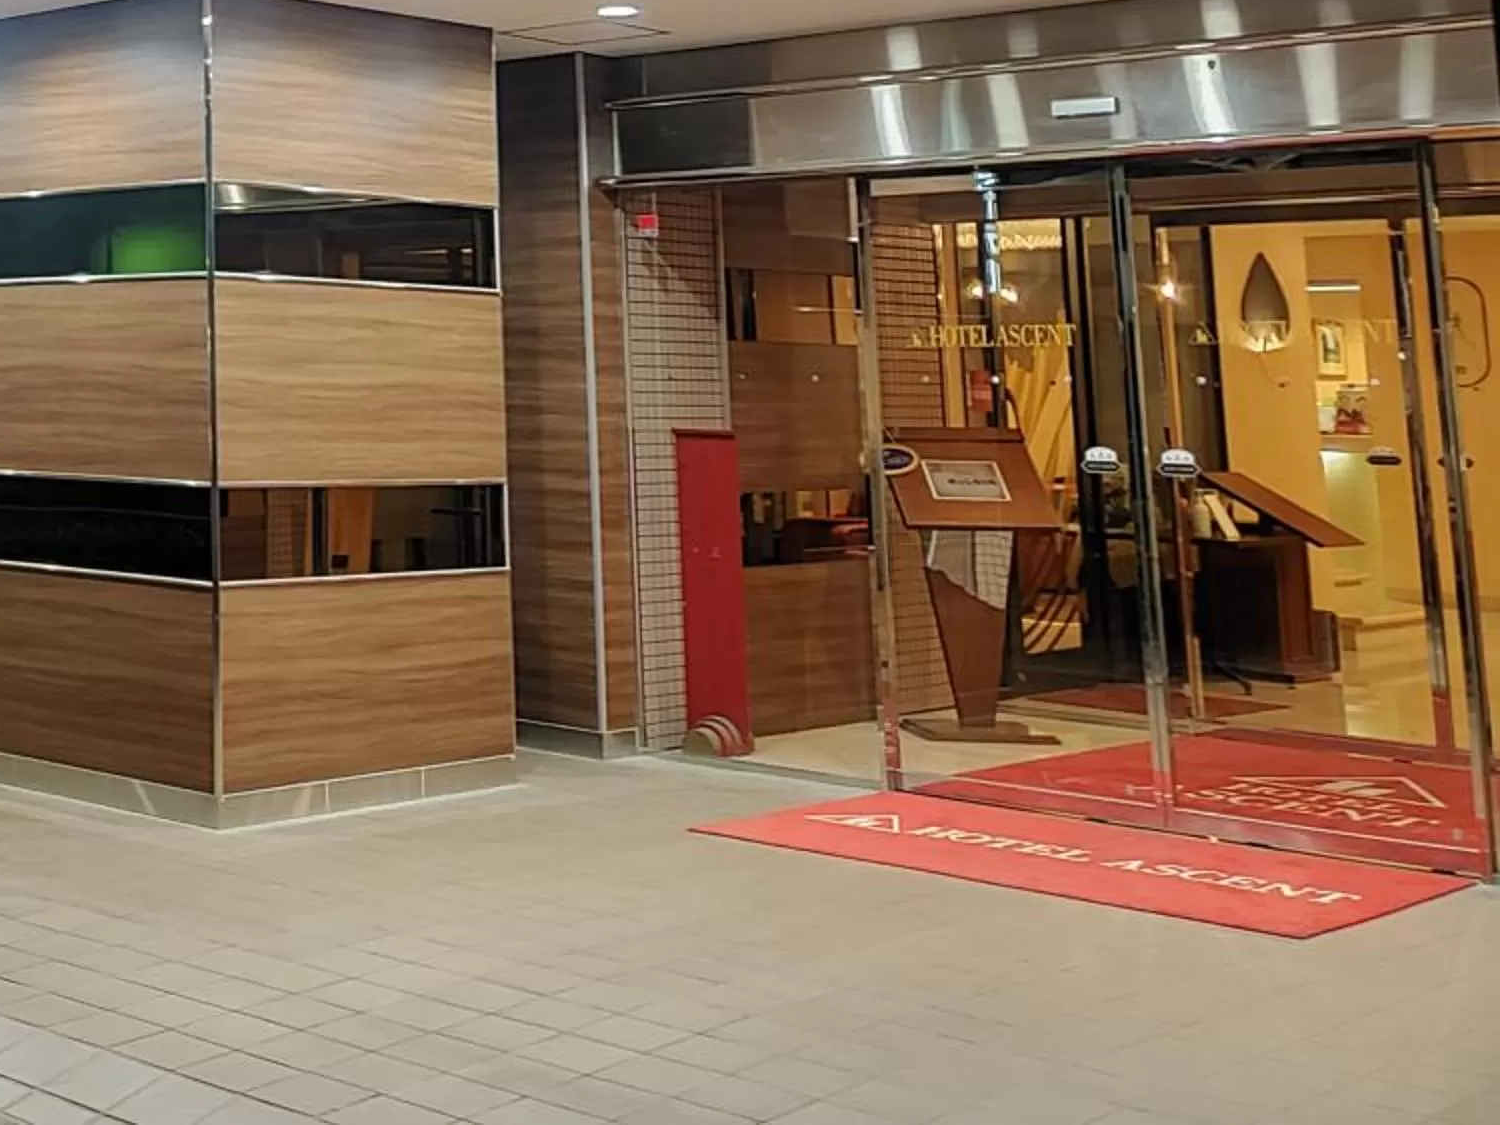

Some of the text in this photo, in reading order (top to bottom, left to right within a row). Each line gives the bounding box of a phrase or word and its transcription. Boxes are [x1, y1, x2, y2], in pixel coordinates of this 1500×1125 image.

[929, 323, 1077, 348] HOTEL ASCENT
[1154, 786, 1441, 827] SCENT
[908, 824, 1363, 906] HOTEL ASCENT
